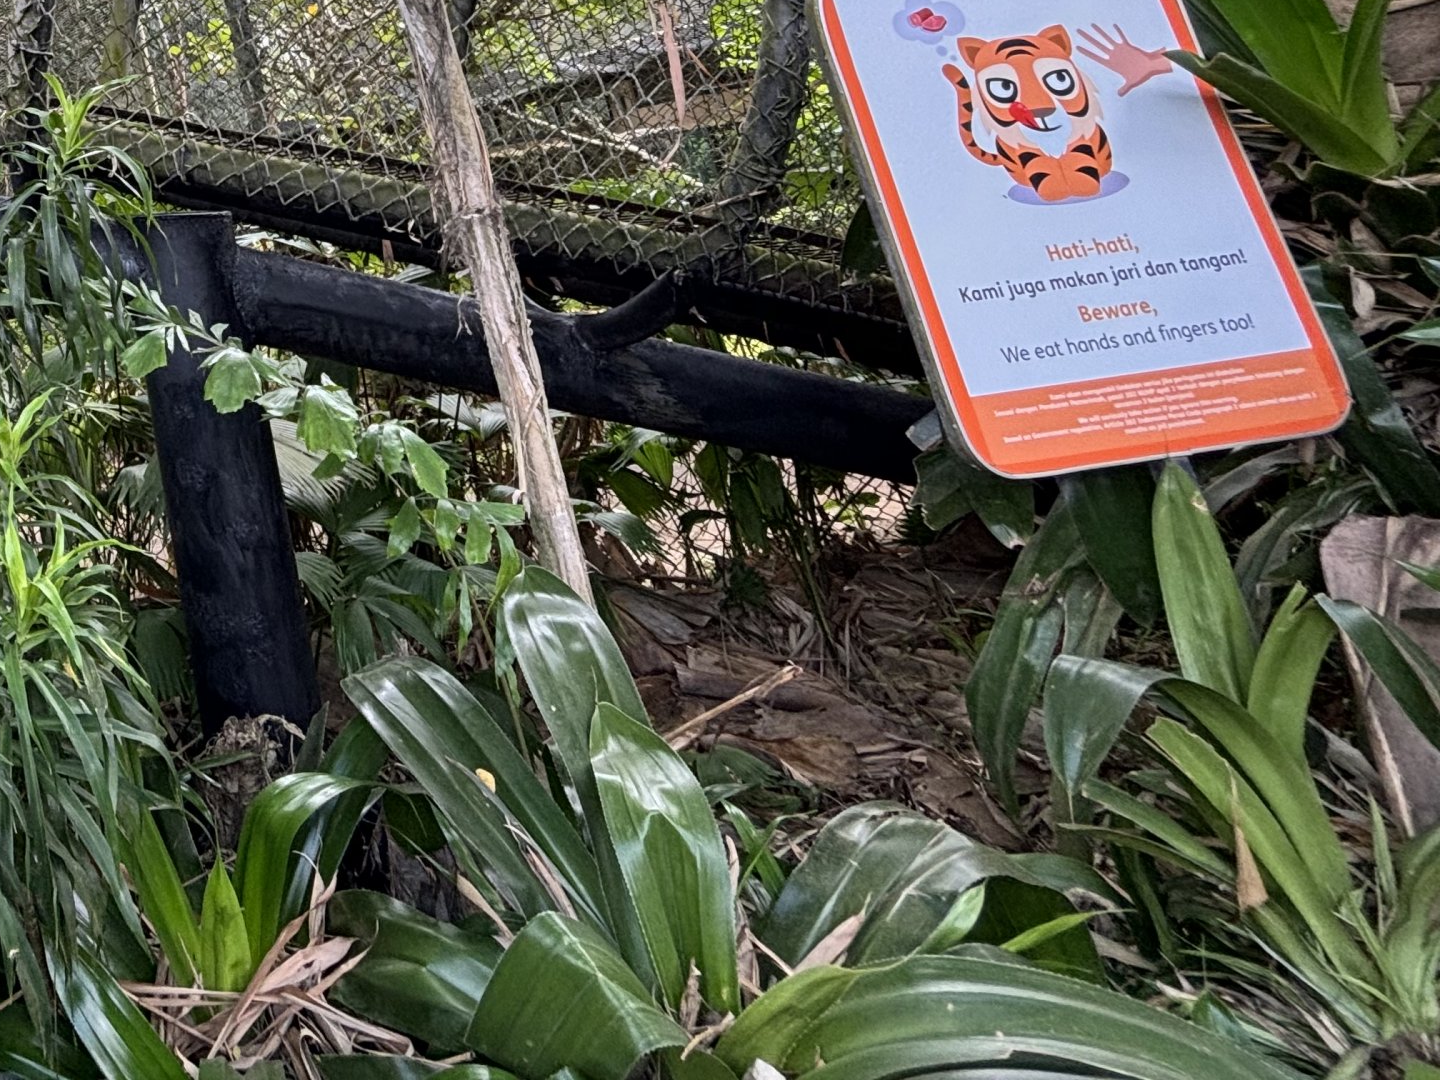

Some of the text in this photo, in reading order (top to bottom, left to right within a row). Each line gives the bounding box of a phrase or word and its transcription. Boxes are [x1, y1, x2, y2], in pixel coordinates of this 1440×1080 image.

[1045, 233, 1139, 262] Hati-hati,
[958, 248, 1248, 303] Kami juga makan jari dan tangan!
[1077, 300, 1158, 323] Beware,
[1000, 313, 1256, 364] We eat hands and fingers too!
